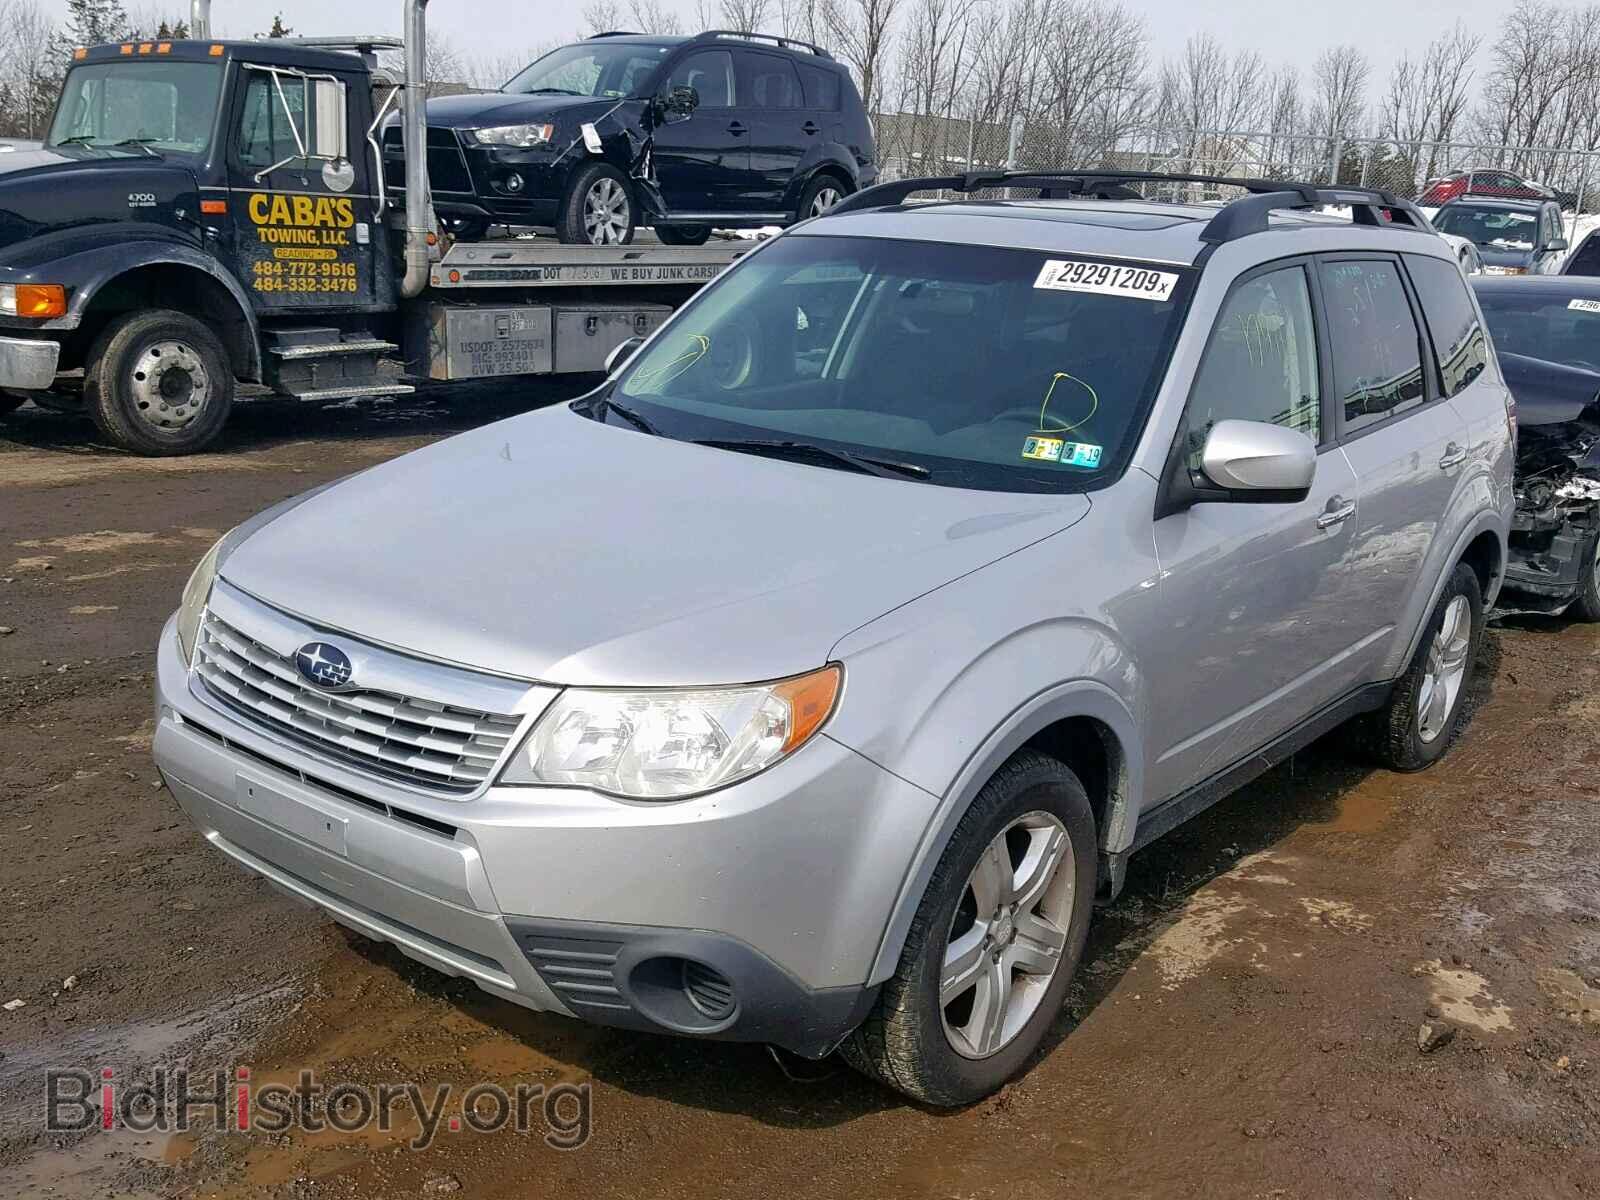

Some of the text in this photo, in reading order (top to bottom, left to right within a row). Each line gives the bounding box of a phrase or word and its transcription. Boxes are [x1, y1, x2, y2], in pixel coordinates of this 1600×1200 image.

[248, 193, 354, 229] CABA'S
[257, 228, 350, 246] TOWING, LLC.
[253, 261, 356, 276] 484-772-9616
[544, 266, 561, 279] DOT
[611, 268, 627, 280] WE
[632, 268, 653, 280] BUY
[656, 267, 686, 280] JUNK
[253, 277, 357, 292] 484-332-3476
[1086, 448, 1100, 462] 19
